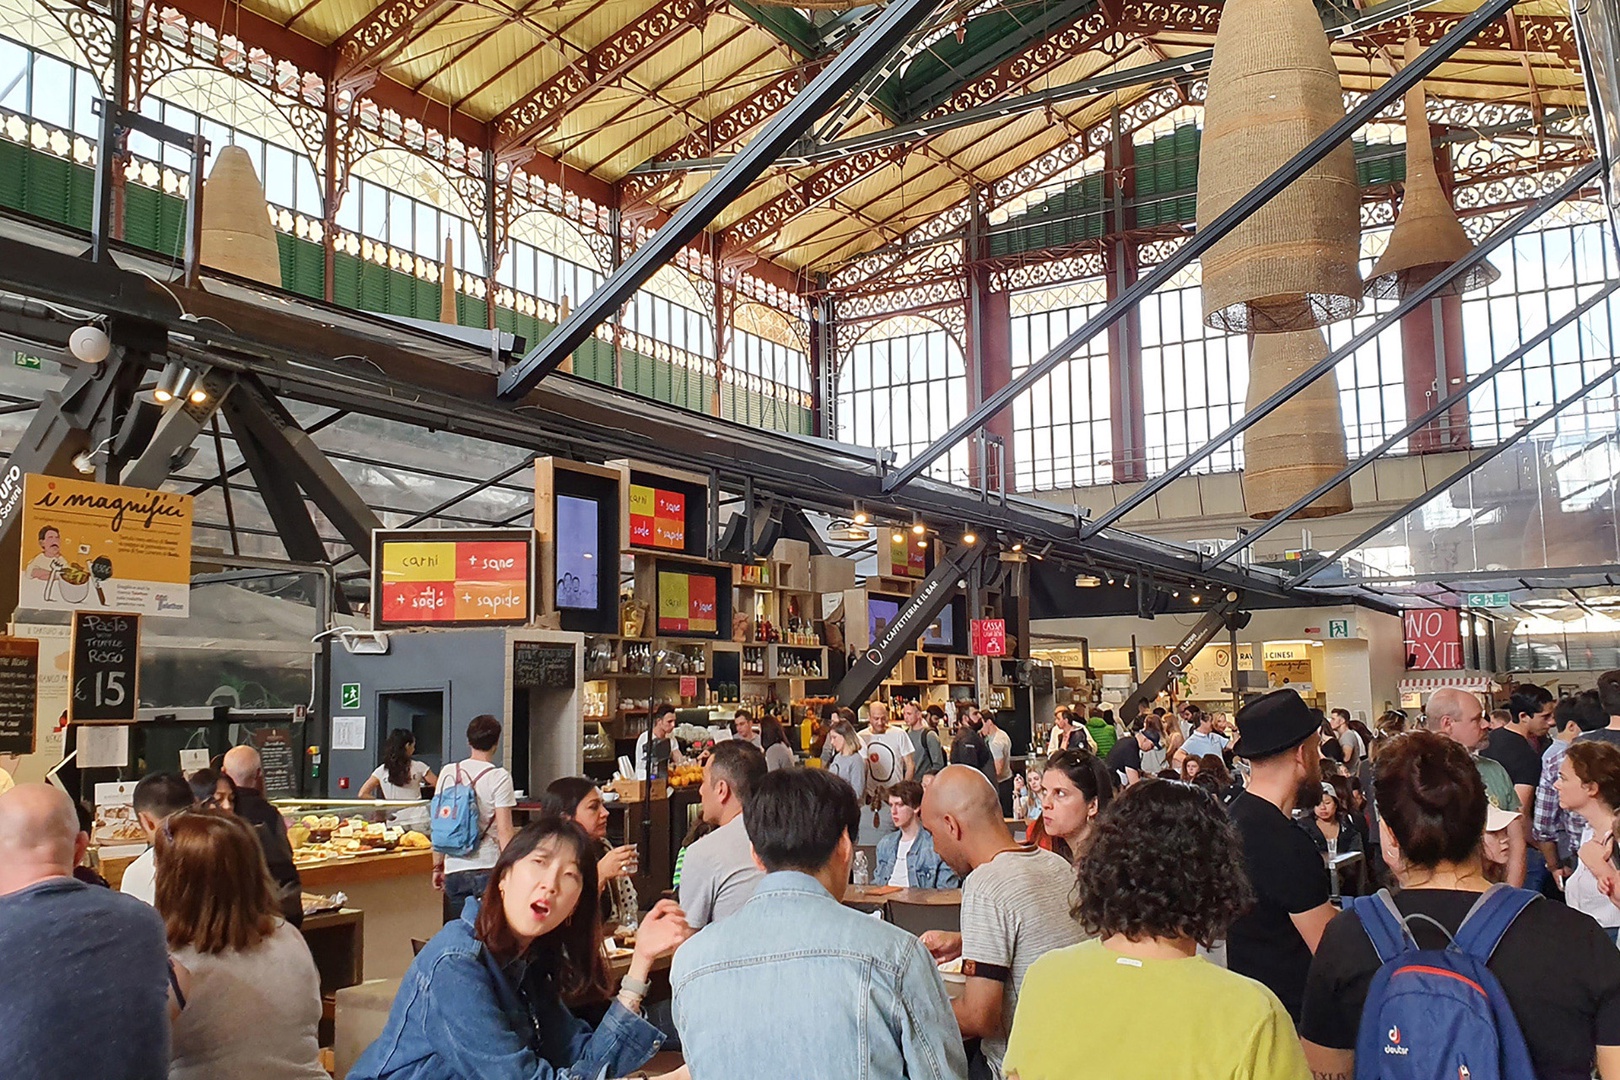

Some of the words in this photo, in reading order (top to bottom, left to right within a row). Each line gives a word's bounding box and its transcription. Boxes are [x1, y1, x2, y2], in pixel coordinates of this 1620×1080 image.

[63, 493, 184, 532] magnifici
[402, 554, 439, 568] carni
[482, 556, 515, 572] sane
[925, 580, 938, 596] BAR
[477, 589, 521, 615] sapide
[982, 621, 1002, 631] CASSA
[1407, 611, 1442, 638] NO
[1269, 651, 1294, 659] CINESI
[1408, 641, 1461, 670] EXIT
[95, 670, 126, 708] 15
[1384, 1044, 1409, 1055] deuter
